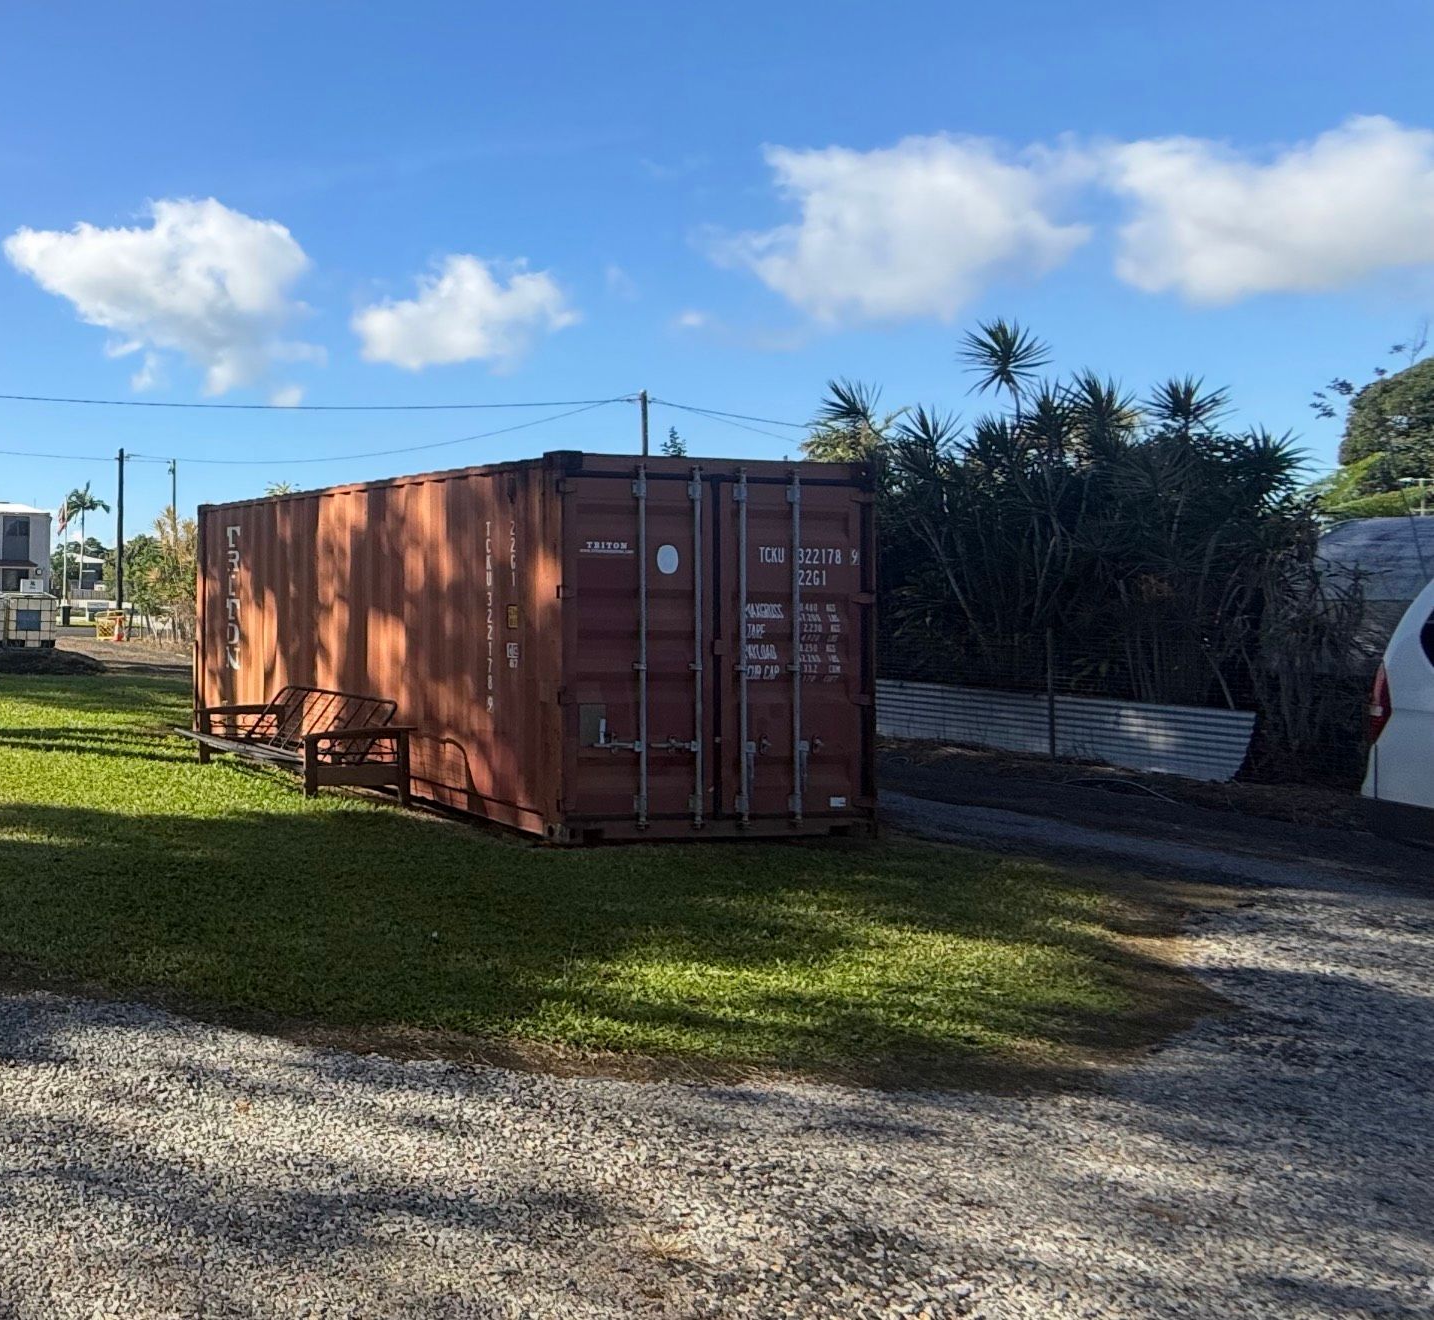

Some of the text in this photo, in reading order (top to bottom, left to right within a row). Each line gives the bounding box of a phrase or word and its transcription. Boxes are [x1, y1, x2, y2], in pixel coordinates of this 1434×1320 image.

[586, 541, 628, 549] TRITON
[759, 546, 860, 565] TCKU 322178 9
[798, 570, 826, 586] 22G1
